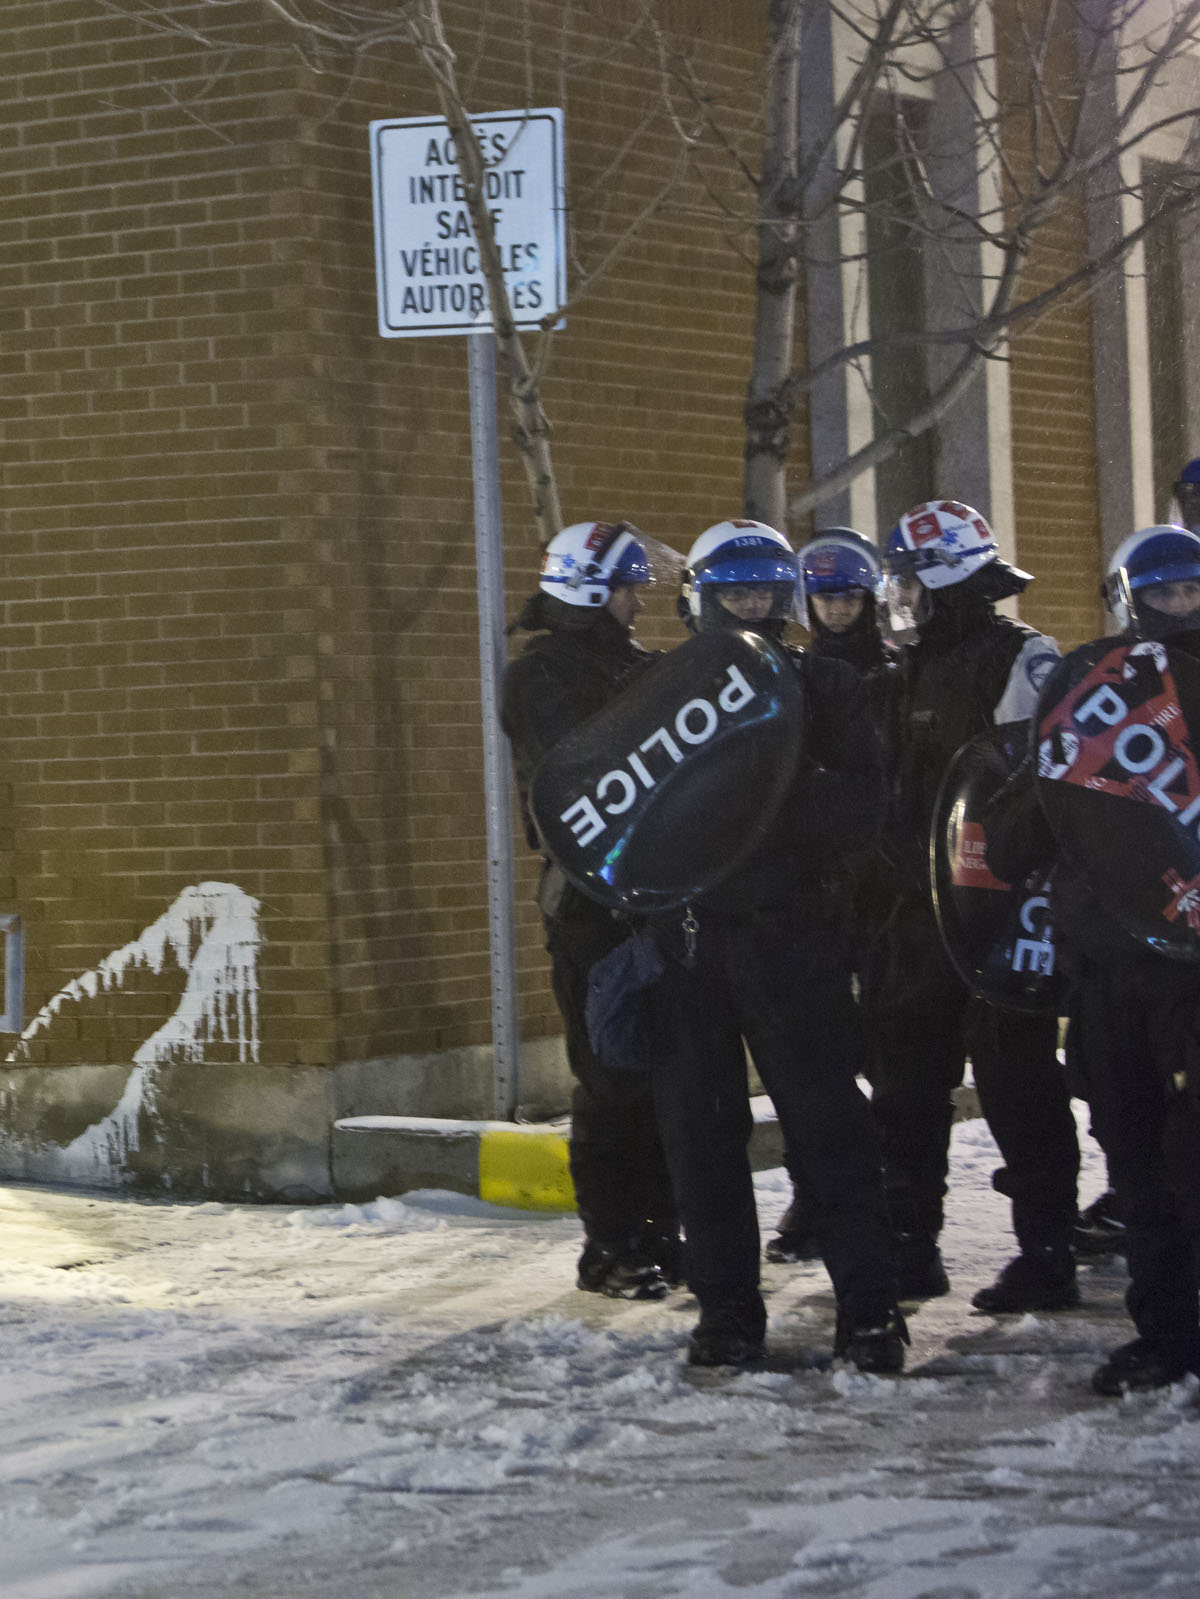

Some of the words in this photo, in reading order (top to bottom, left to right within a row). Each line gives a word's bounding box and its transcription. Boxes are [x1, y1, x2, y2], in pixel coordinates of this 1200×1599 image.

[425, 128, 507, 167] ACÈS
[409, 170, 526, 204] INTEDIT
[436, 208, 503, 240] SAF
[400, 242, 540, 277] VÉHICLES
[401, 280, 543, 314] AUTORES
[560, 664, 757, 848] POLICE
[1074, 684, 1200, 842] POLI
